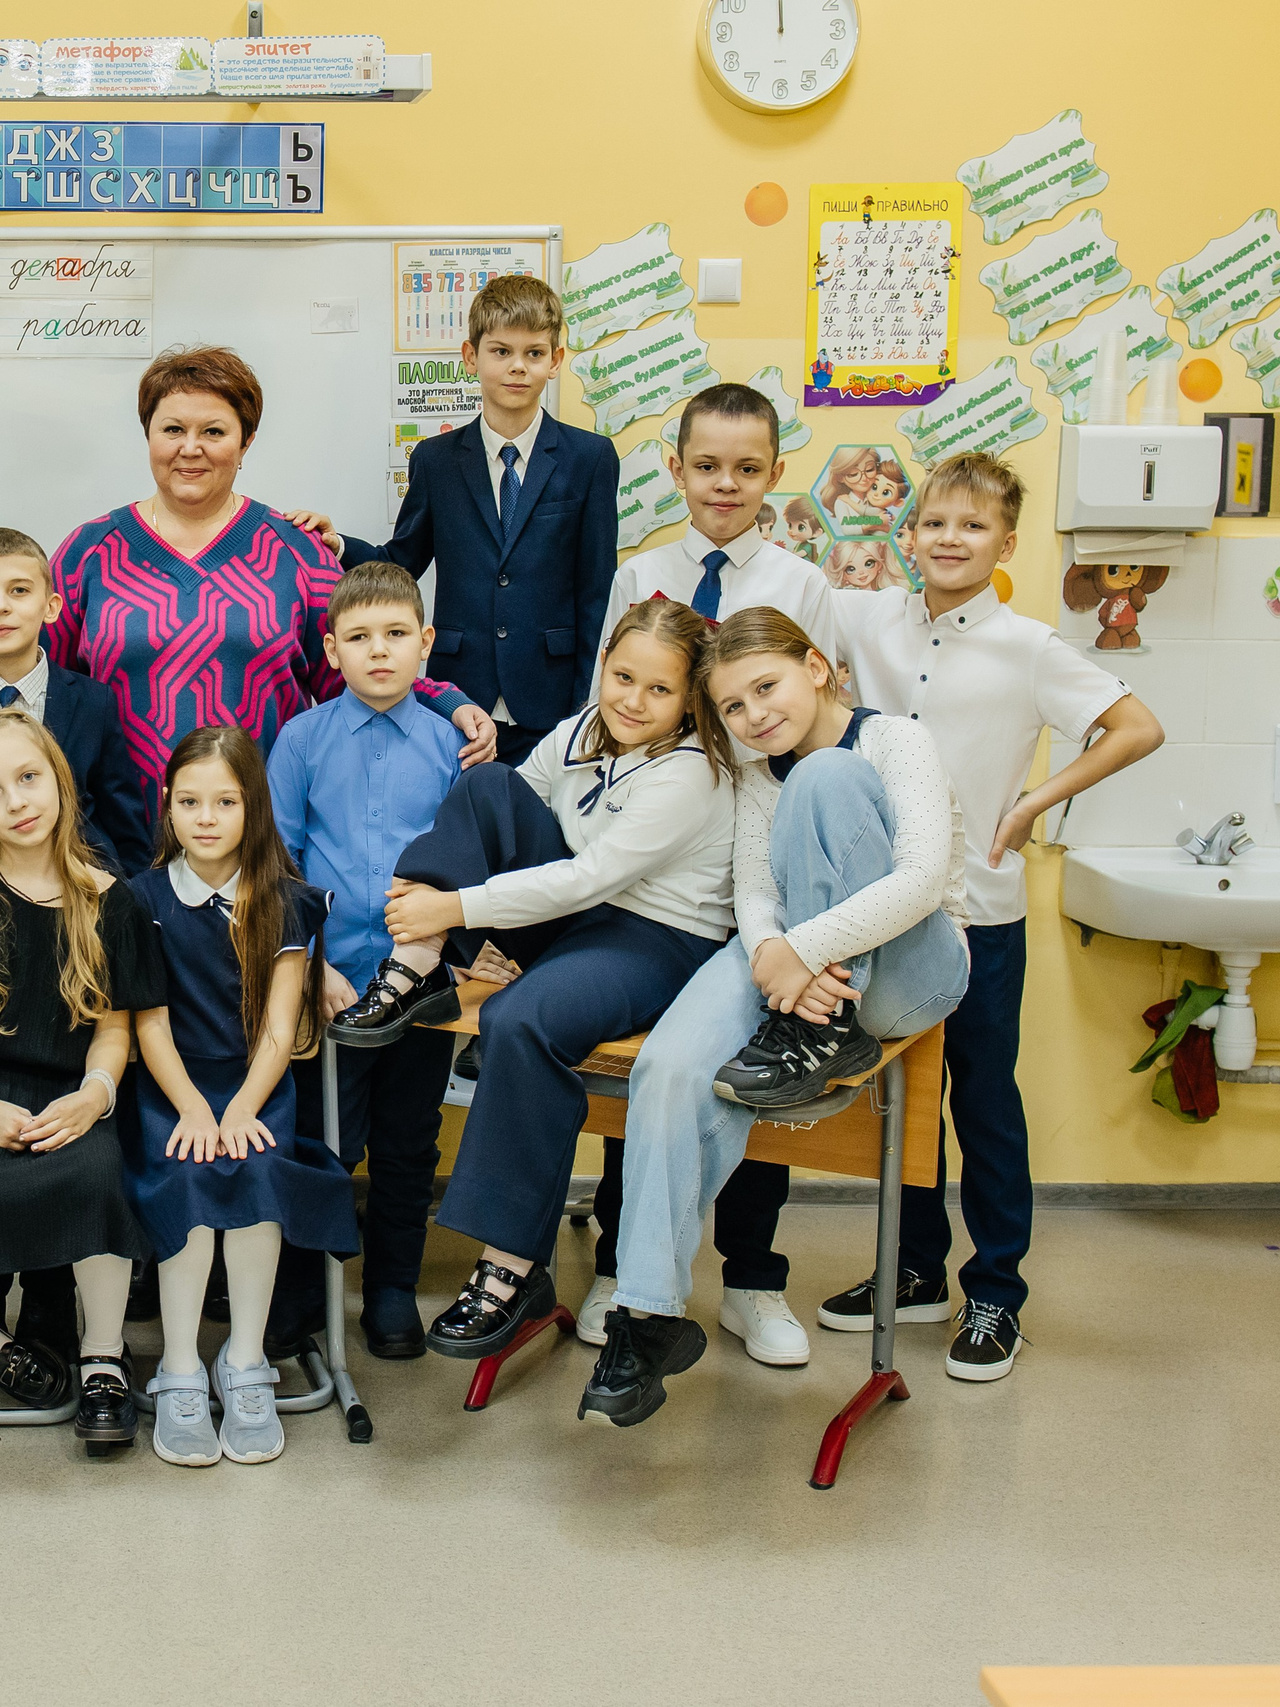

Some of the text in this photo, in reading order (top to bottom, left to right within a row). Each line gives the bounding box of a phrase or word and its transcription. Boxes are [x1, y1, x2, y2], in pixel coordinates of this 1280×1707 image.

[716, 22, 732, 43] 9
[829, 19, 846, 40] 3
[56, 41, 154, 62] метафора
[244, 43, 312, 56] эпитет
[821, 48, 838, 69] 4
[219, 64, 354, 74] красочное определение чего-либо
[242, 58, 280, 66] средство
[282, 57, 354, 66] выразительности,
[723, 51, 740, 71] 8
[220, 73, 242, 81] (чаще
[245, 73, 266, 81] всего
[286, 72, 352, 81] прилагательное).
[744, 72, 760, 92] 7
[800, 70, 817, 91] 5
[772, 79, 788, 99] 6
[7, 129, 39, 165] Д
[45, 129, 81, 161] Ж
[90, 129, 114, 161] З
[292, 131, 314, 163] Ь
[972, 138, 1086, 201] Хорошая книга ярче
[1048, 159, 1091, 186] светит
[12, 171, 36, 203] Т
[45, 171, 81, 204] Ш
[89, 171, 117, 204] С
[127, 172, 157, 204] Х
[168, 172, 196, 207] Ц
[208, 172, 232, 204] Ч
[242, 172, 280, 208] Щ
[286, 174, 313, 205] Ъ
[823, 199, 949, 212] ПИШИ ПРАВИЛЬНО
[429, 248, 454, 256] КЛАССЫ
[461, 247, 491, 256] РАЗРЯДЫ
[493, 247, 512, 255] ЧИСЕЛ
[8, 244, 136, 292] декабря
[581, 255, 665, 299] умного соседа
[1177, 238, 1261, 295] Книга поможет
[1225, 255, 1273, 291] выручит
[402, 272, 465, 293] 835 772
[1003, 273, 1041, 298] Книга
[1040, 257, 1069, 277] твой
[1008, 303, 1031, 319] без
[1051, 279, 1074, 296] как
[1073, 267, 1094, 283] без
[1093, 255, 1117, 277] рук
[567, 271, 680, 326] с книгой побеседуй
[1231, 289, 1260, 311] беде
[17, 303, 146, 351] работа
[638, 332, 685, 358] книжки
[590, 348, 702, 401] читать, будешь все
[398, 397, 426, 405] ПЛОСКОЙ
[408, 388, 463, 397] ЭТО ВНУТРЕННЯЯ
[637, 385, 671, 405] знать
[410, 405, 450, 413] ОБОЗНАЧАТЬ
[452, 402, 476, 411] БУКВОЙ
[913, 413, 955, 440] Золото
[957, 377, 1012, 419] добывают
[939, 396, 1023, 451] земли, а знания
[619, 469, 660, 496] лучшее
[841, 516, 883, 526] ЛЮБОВЬ
